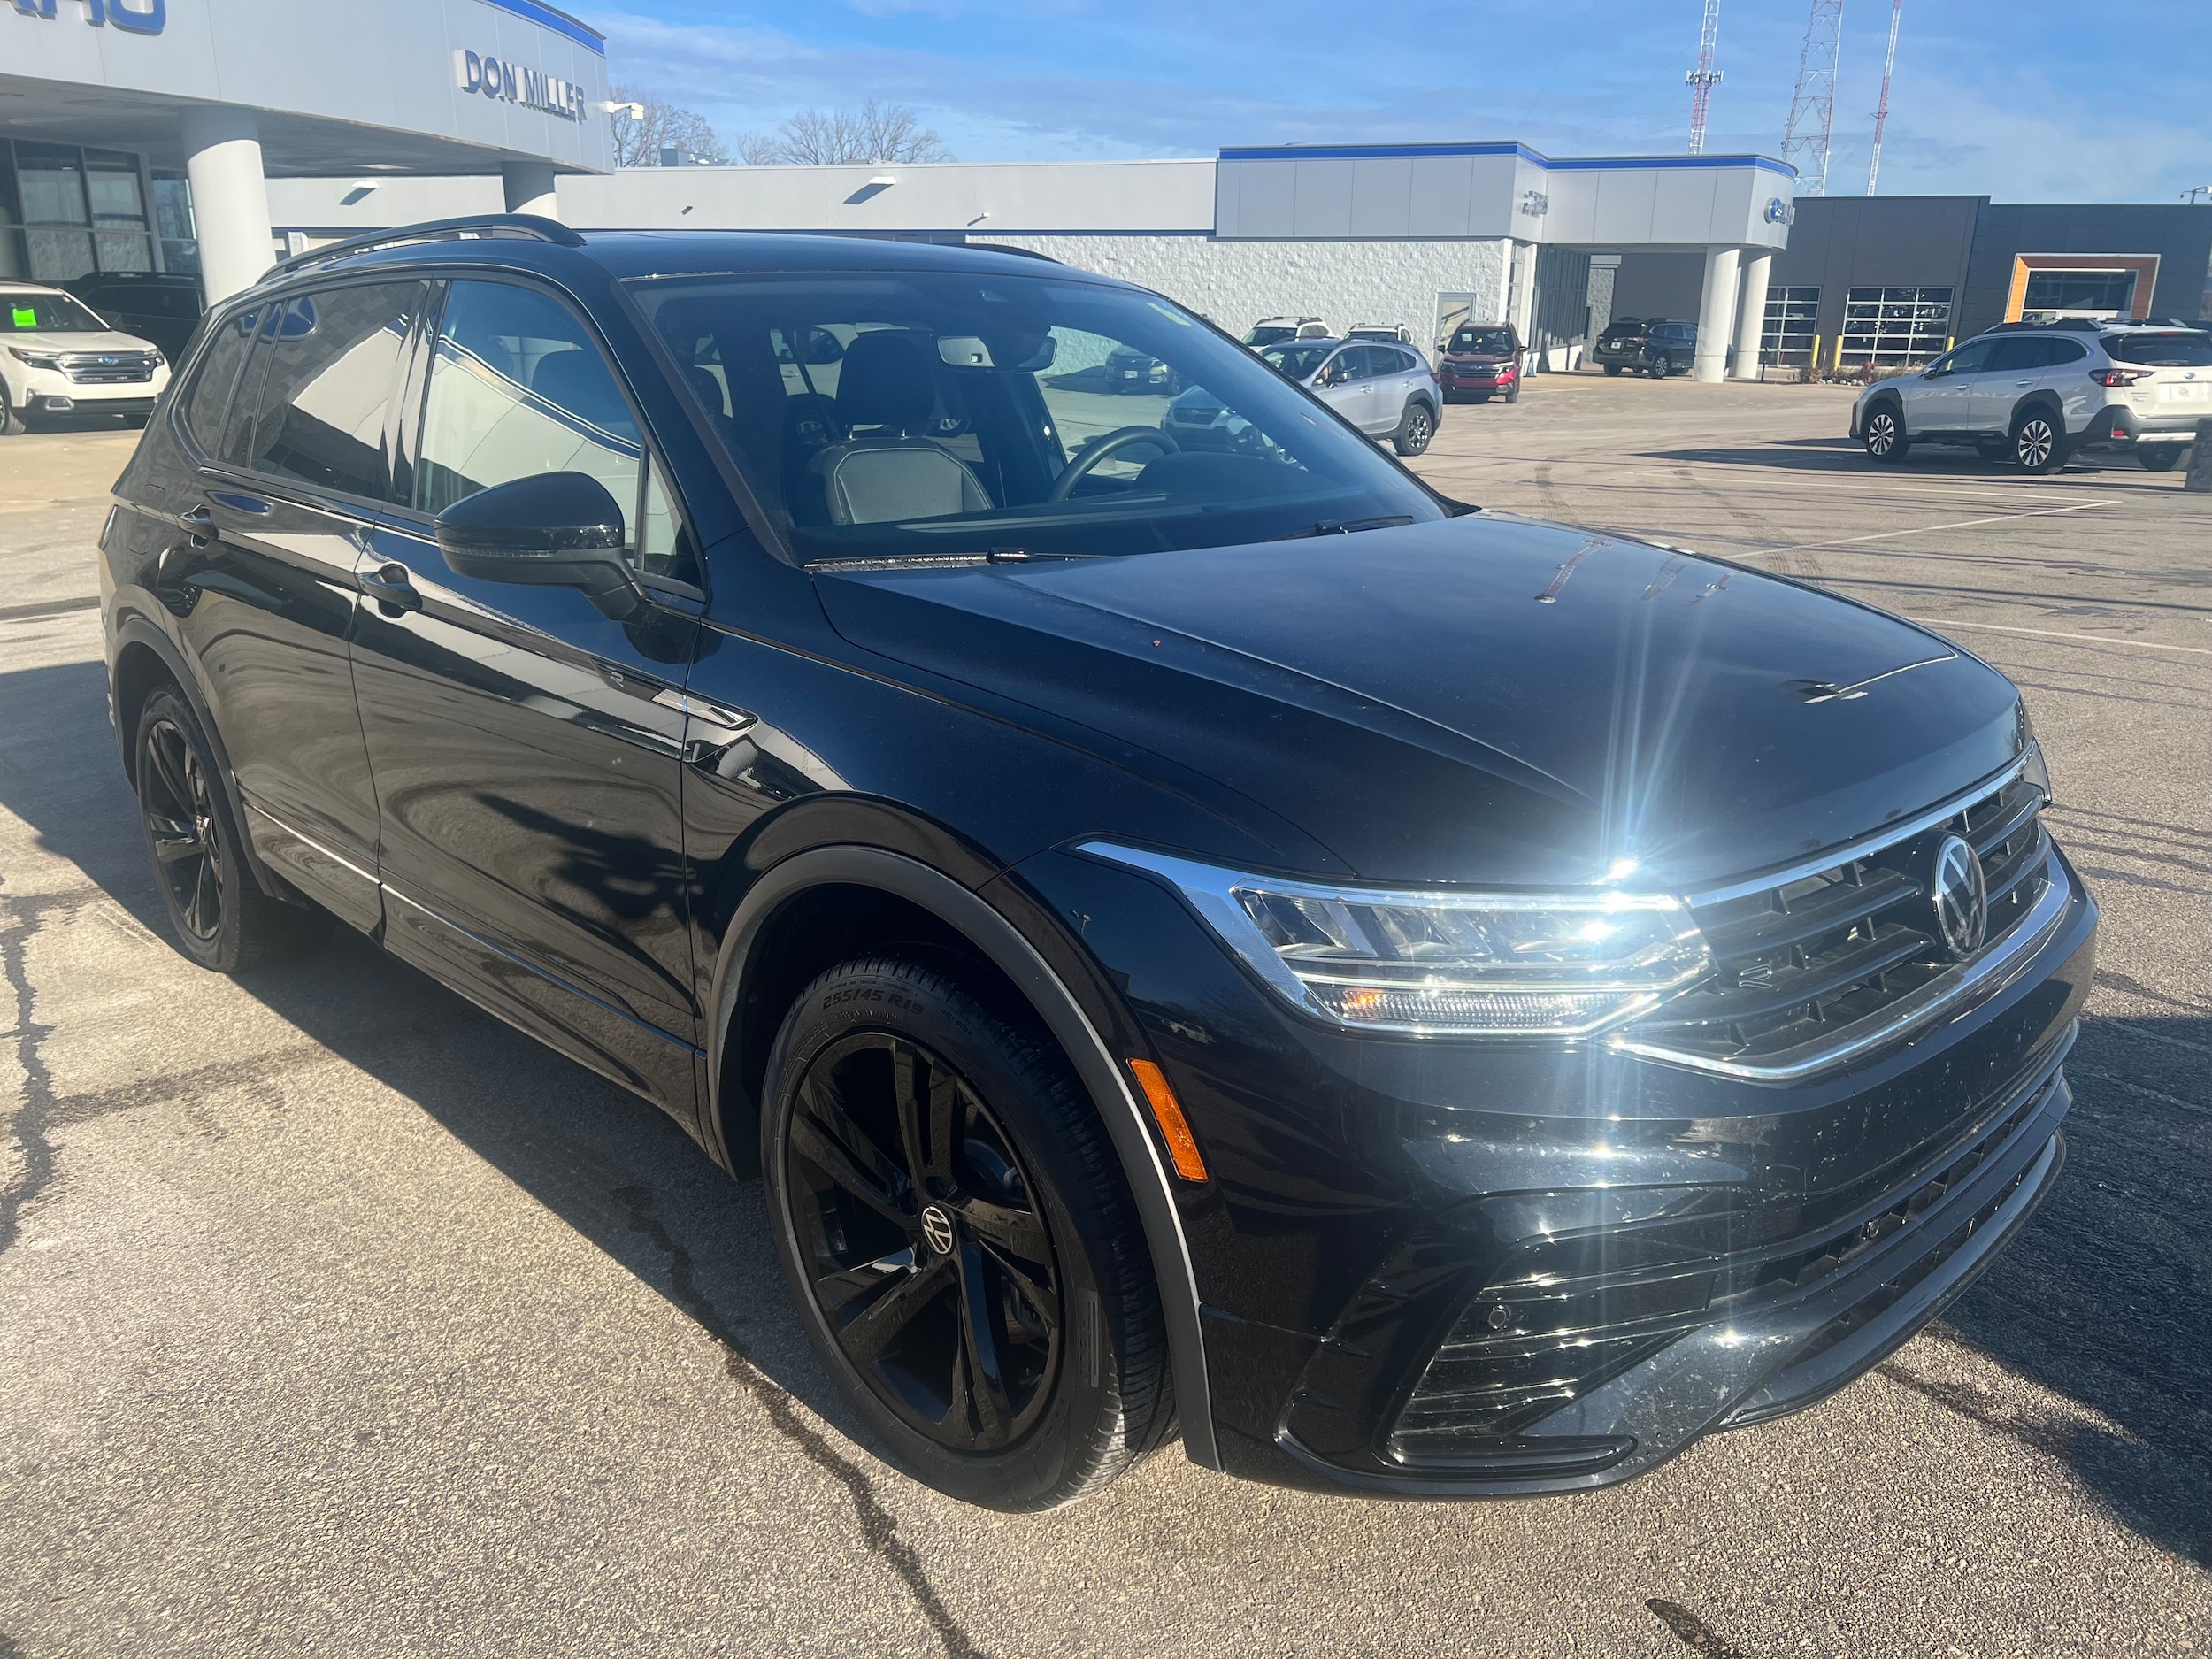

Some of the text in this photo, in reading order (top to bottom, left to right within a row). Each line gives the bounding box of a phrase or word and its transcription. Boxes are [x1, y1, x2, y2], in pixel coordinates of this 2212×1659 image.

[458, 50, 588, 122] DON MILLER
[822, 987, 924, 1015] 255/45 R19
[940, 1008, 975, 1037] OUTSIDE
